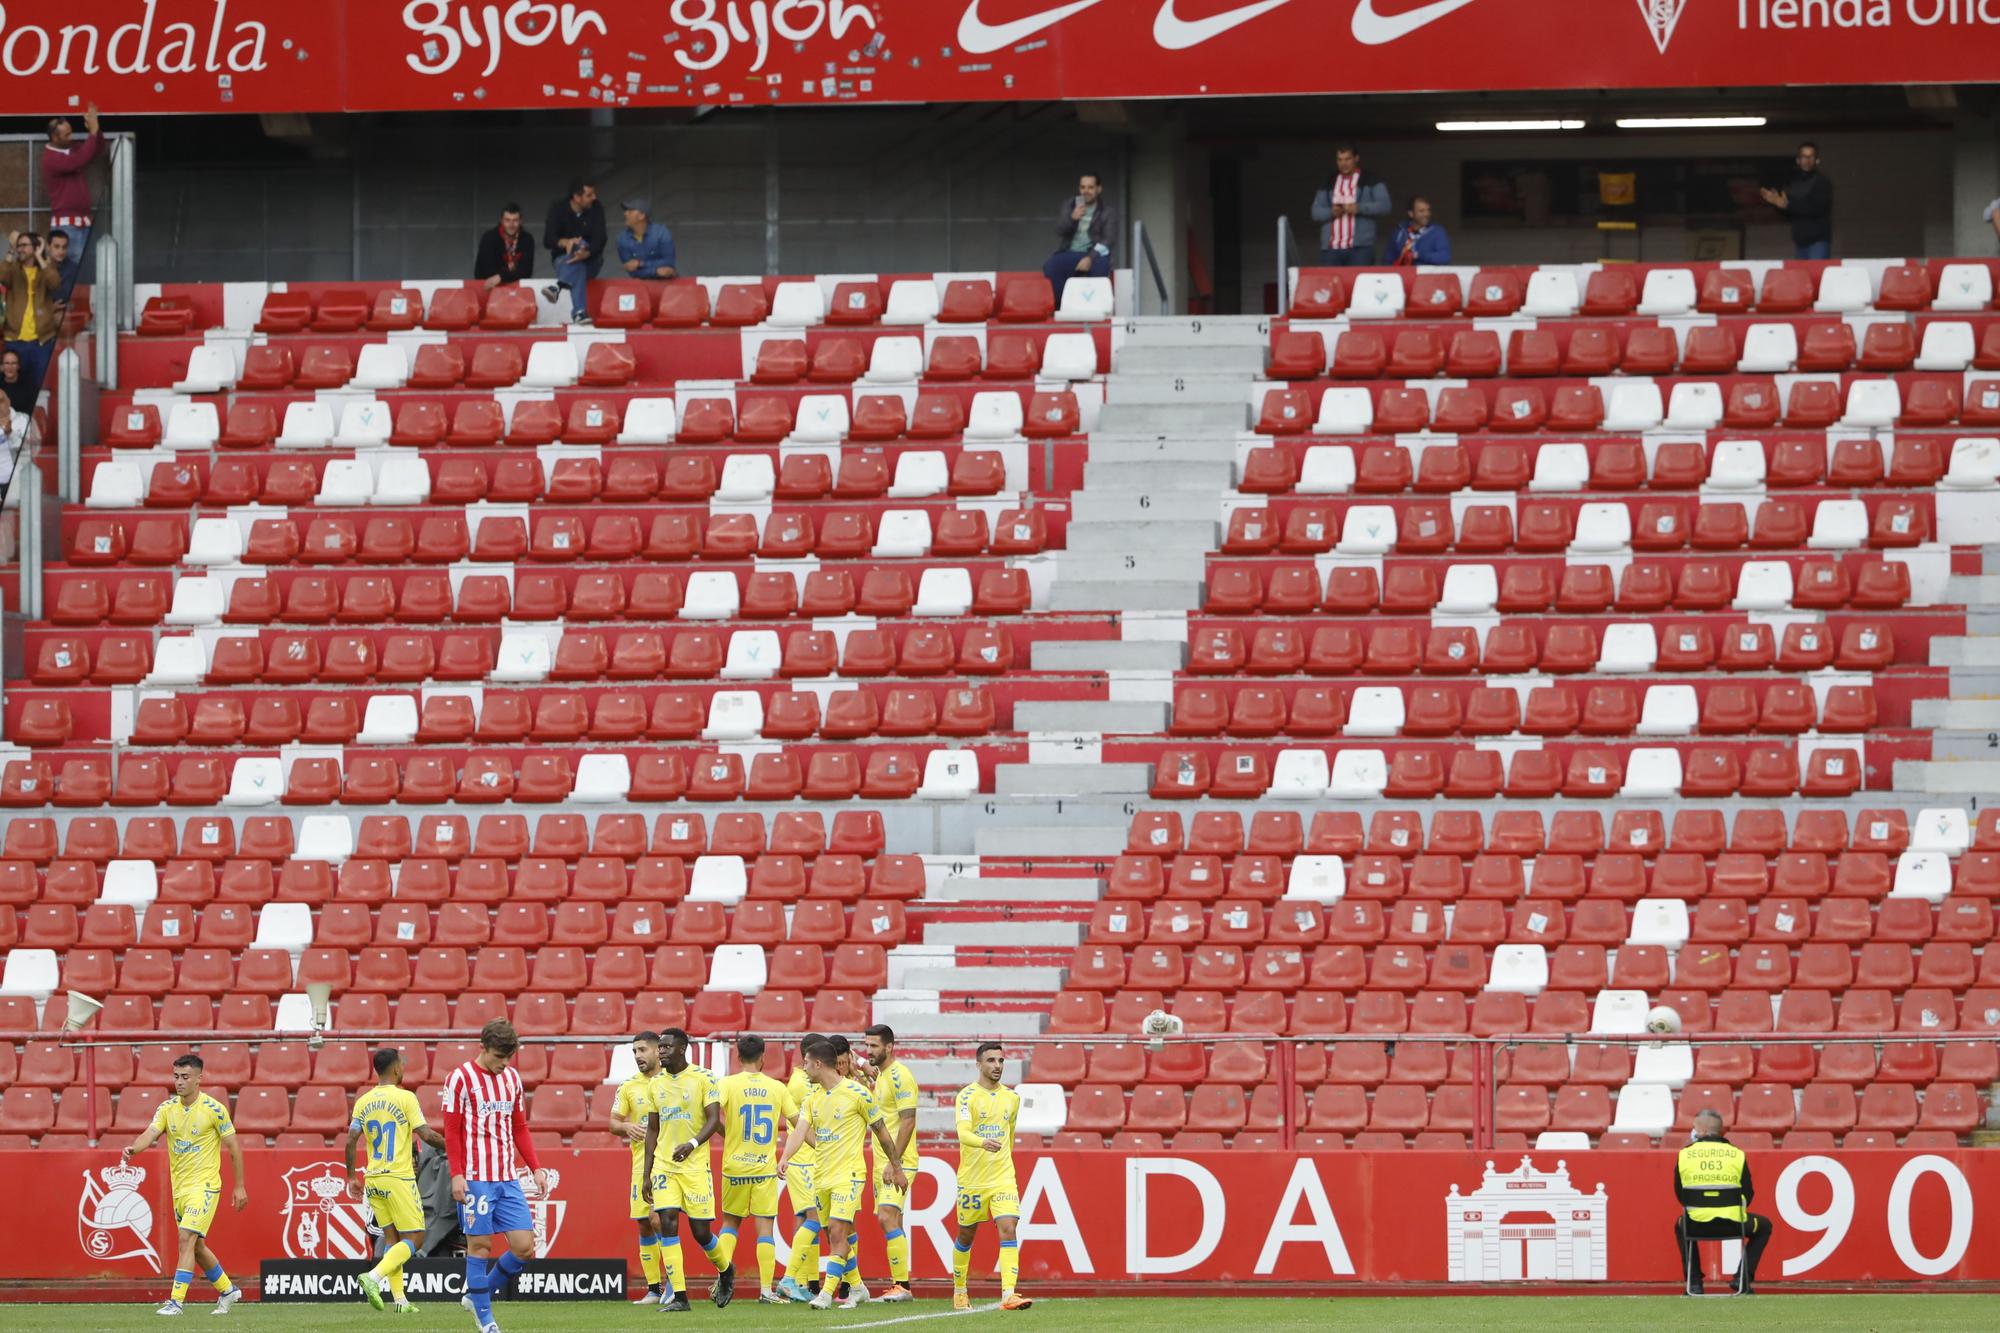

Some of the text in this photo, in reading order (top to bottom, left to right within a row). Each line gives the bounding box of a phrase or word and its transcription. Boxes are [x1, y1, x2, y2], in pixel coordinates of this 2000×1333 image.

[0, 0, 268, 77] ondala
[1175, 378, 1185, 391] 8
[743, 1087, 768, 1098] FABIO
[388, 1102, 408, 1126] VIERA
[738, 1103, 774, 1145] 15
[367, 1119, 397, 1163] 21
[1687, 1149, 1737, 1159] SEGURIDAD
[1700, 1160, 1723, 1171] 063
[652, 1174, 667, 1190] 22
[1693, 1173, 1738, 1184] PROSEGUR
[465, 1193, 489, 1216] 26
[961, 1194, 982, 1210] 25
[773, 1157, 1356, 1275] RADA
[517, 1273, 623, 1294] #FANCAM
